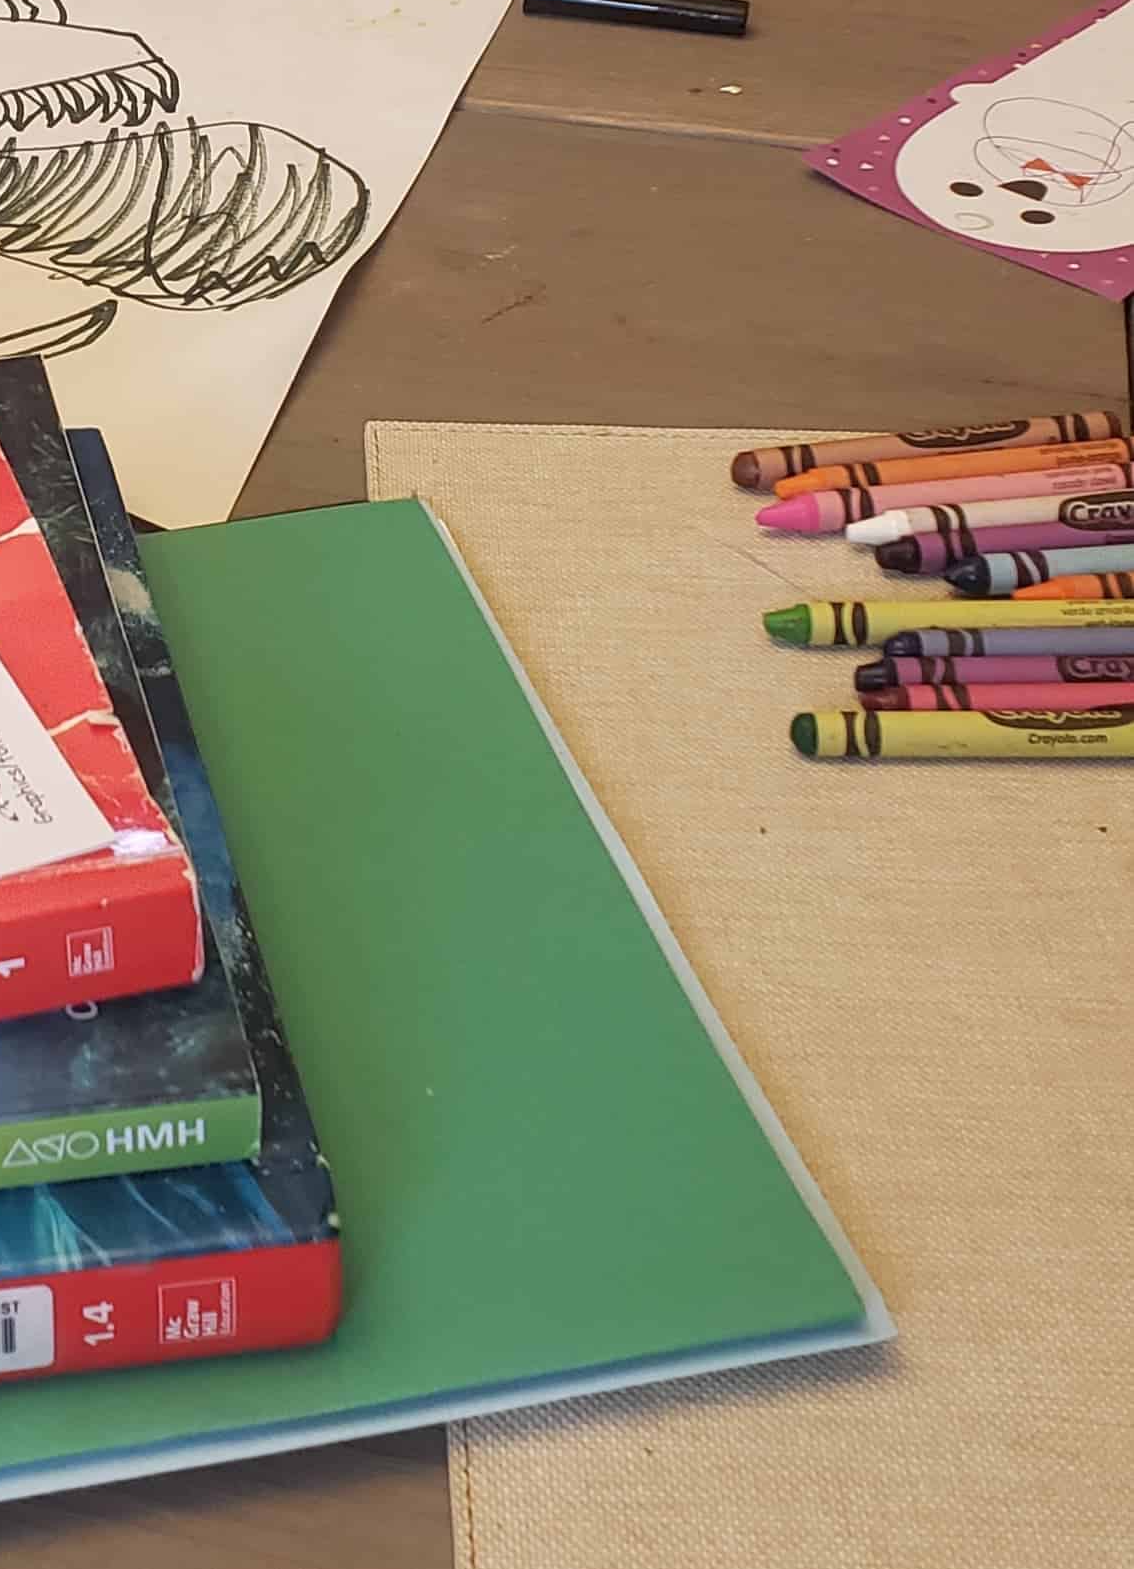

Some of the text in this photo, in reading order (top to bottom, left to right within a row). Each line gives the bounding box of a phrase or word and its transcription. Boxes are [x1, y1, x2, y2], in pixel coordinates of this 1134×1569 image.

[1028, 733, 1108, 747] Crayola.com
[106, 1119, 205, 1155] HMH
[82, 1300, 115, 1346] 1.4
